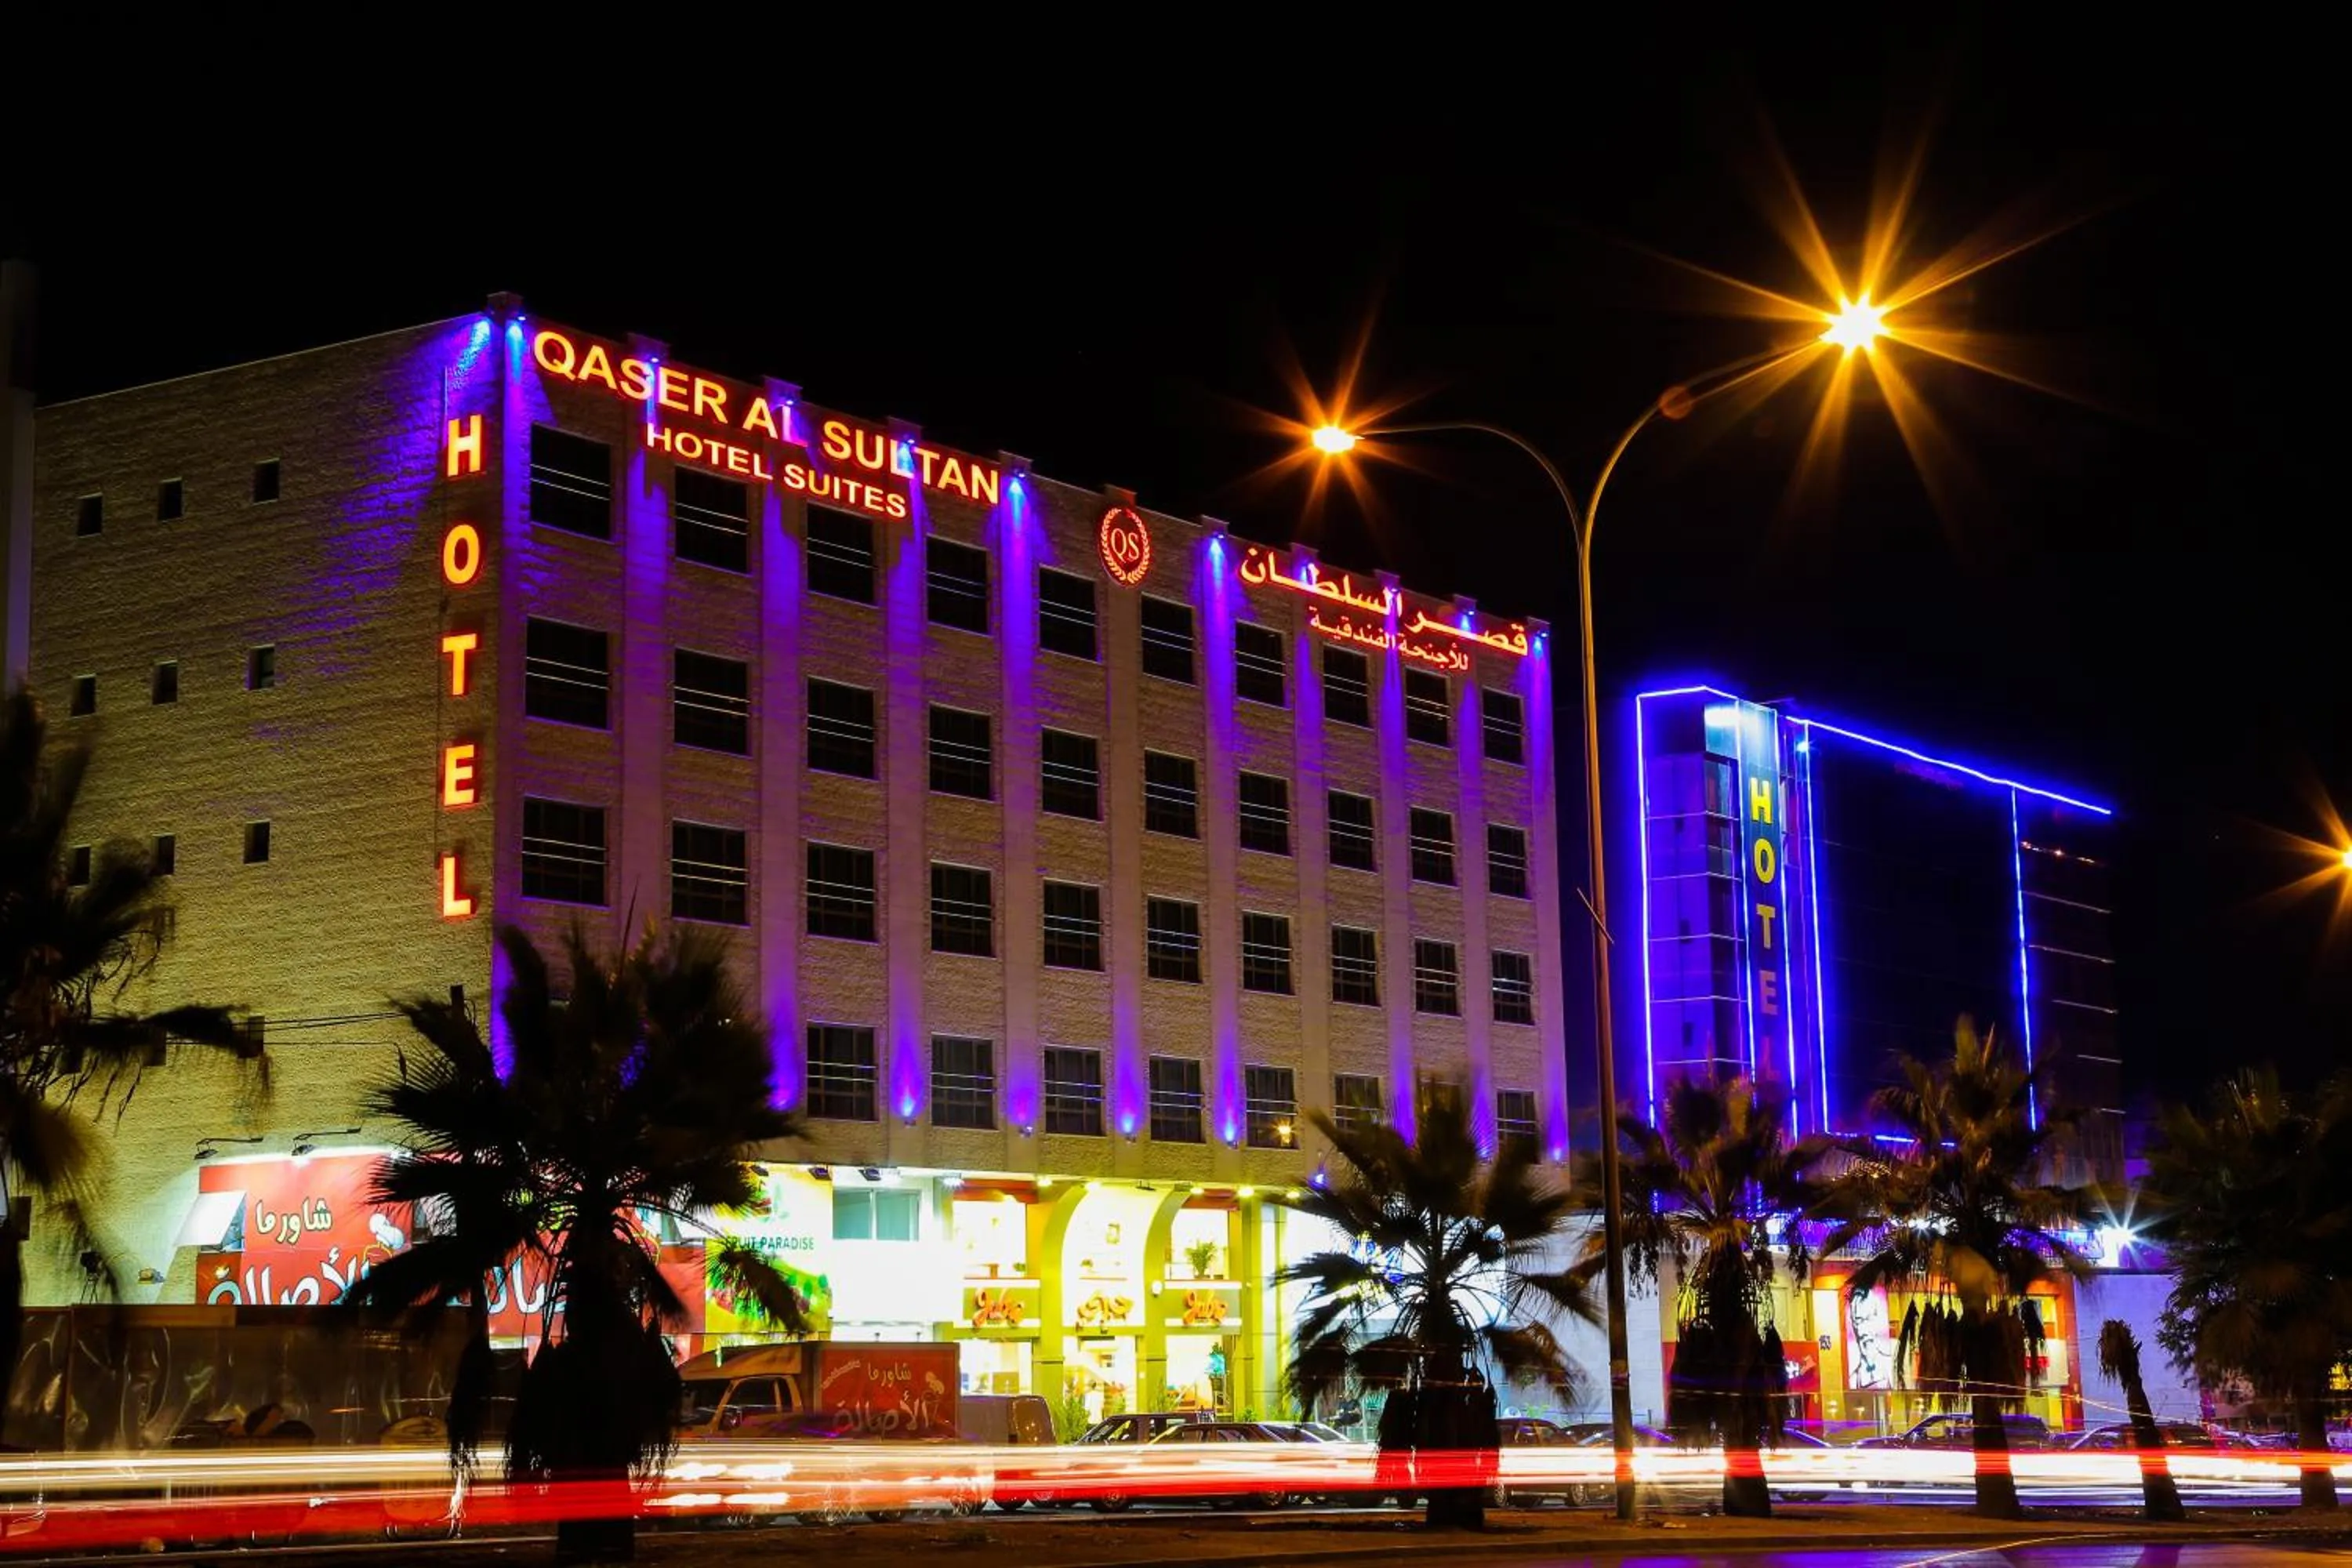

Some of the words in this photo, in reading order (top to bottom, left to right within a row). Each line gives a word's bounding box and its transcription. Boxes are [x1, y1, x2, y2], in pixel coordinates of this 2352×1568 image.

[534, 331, 728, 424] QASER
[743, 397, 808, 447] AL
[822, 420, 999, 504] SULTAN
[647, 423, 773, 481] HOTEL
[784, 463, 906, 518] SUITES
[1111, 527, 1139, 564] QS
[1240, 548, 1402, 618] السلطان
[1404, 611, 1528, 656] قصر
[443, 414, 481, 917] HOTEL
[1750, 777, 1780, 1081] HOTEL
[255, 1196, 333, 1244] شاورما
[760, 1236, 815, 1250] PARADISE
[867, 1361, 912, 1388] شاورما
